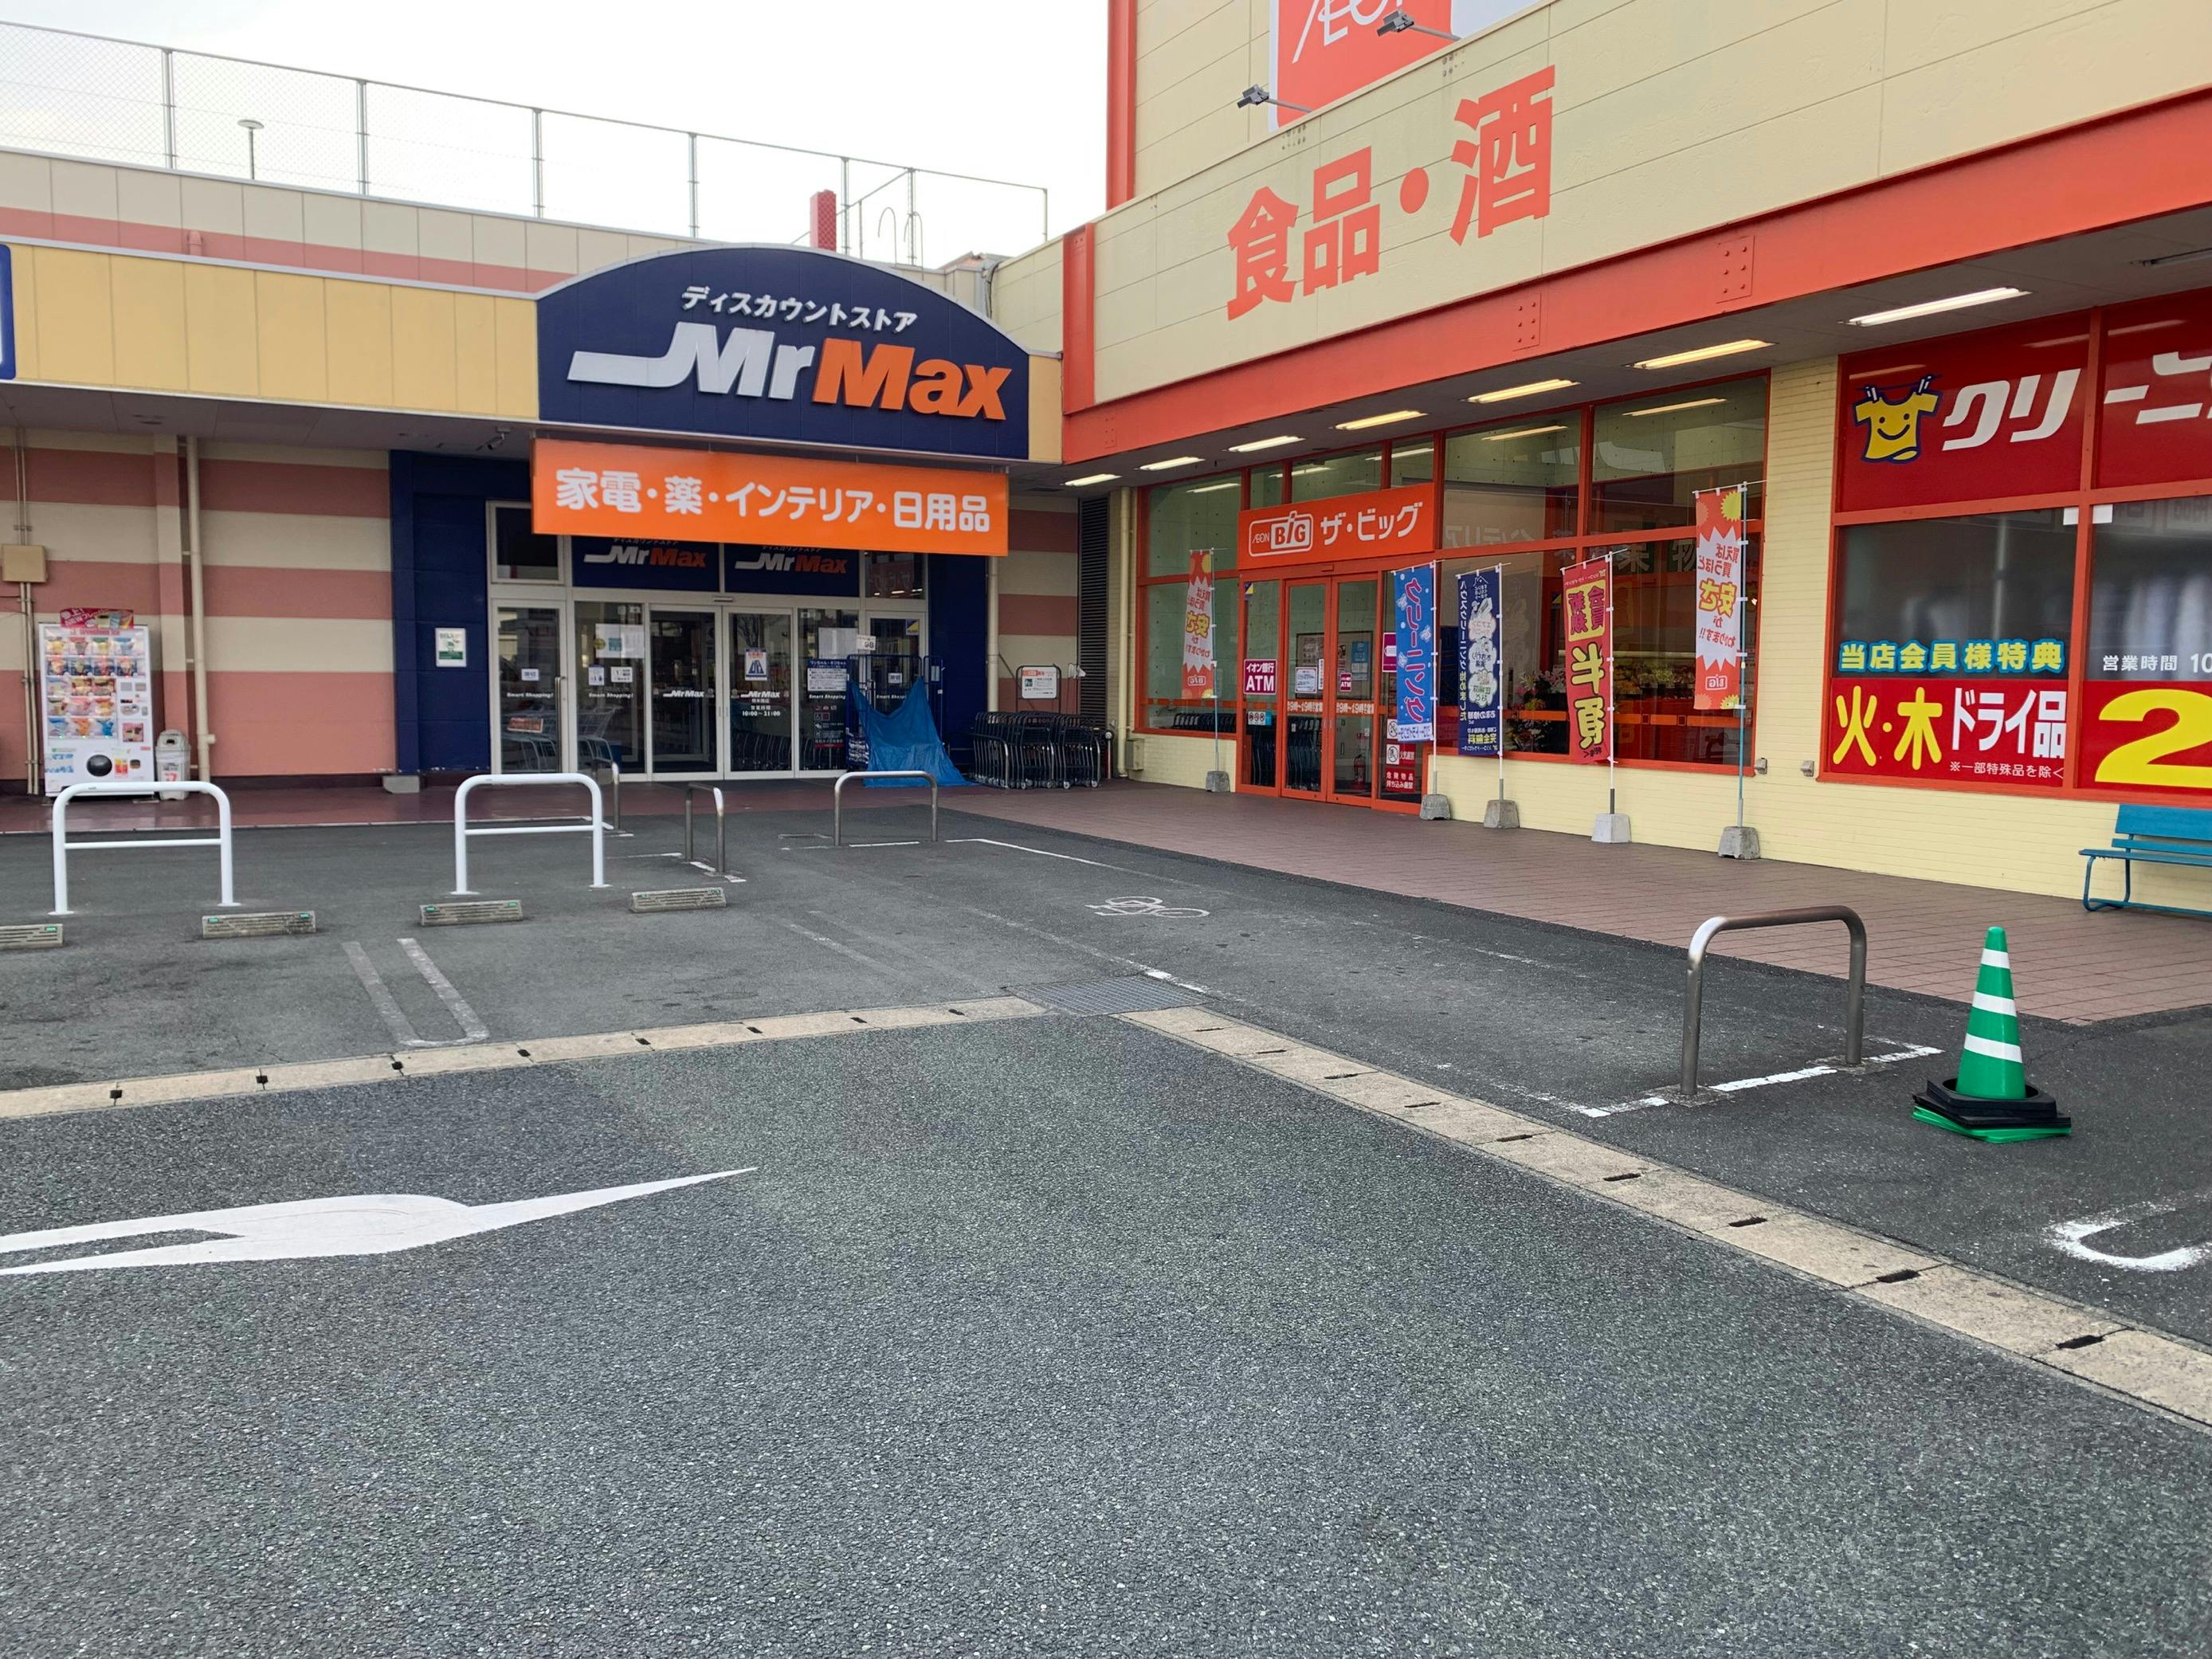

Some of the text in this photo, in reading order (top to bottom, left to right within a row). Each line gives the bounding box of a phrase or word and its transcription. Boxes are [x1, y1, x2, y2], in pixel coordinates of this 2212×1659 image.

[1227, 65, 1555, 321] 食品・酒
[682, 285, 918, 333] ディスカウントストア
[567, 321, 1012, 421] MrMax
[1941, 351, 2212, 451] クリーニ
[555, 468, 990, 533] 家電・薬・インテリア・日用品
[1320, 501, 1423, 546] ザ・ビッグ
[583, 545, 707, 568] MrMax
[735, 552, 849, 575] MrMax
[1246, 662, 1274, 673] イオン銀行
[1838, 639, 2065, 673] 当店会員様特典
[2103, 655, 2178, 672] 営業時間
[1245, 675, 1274, 692] ATM
